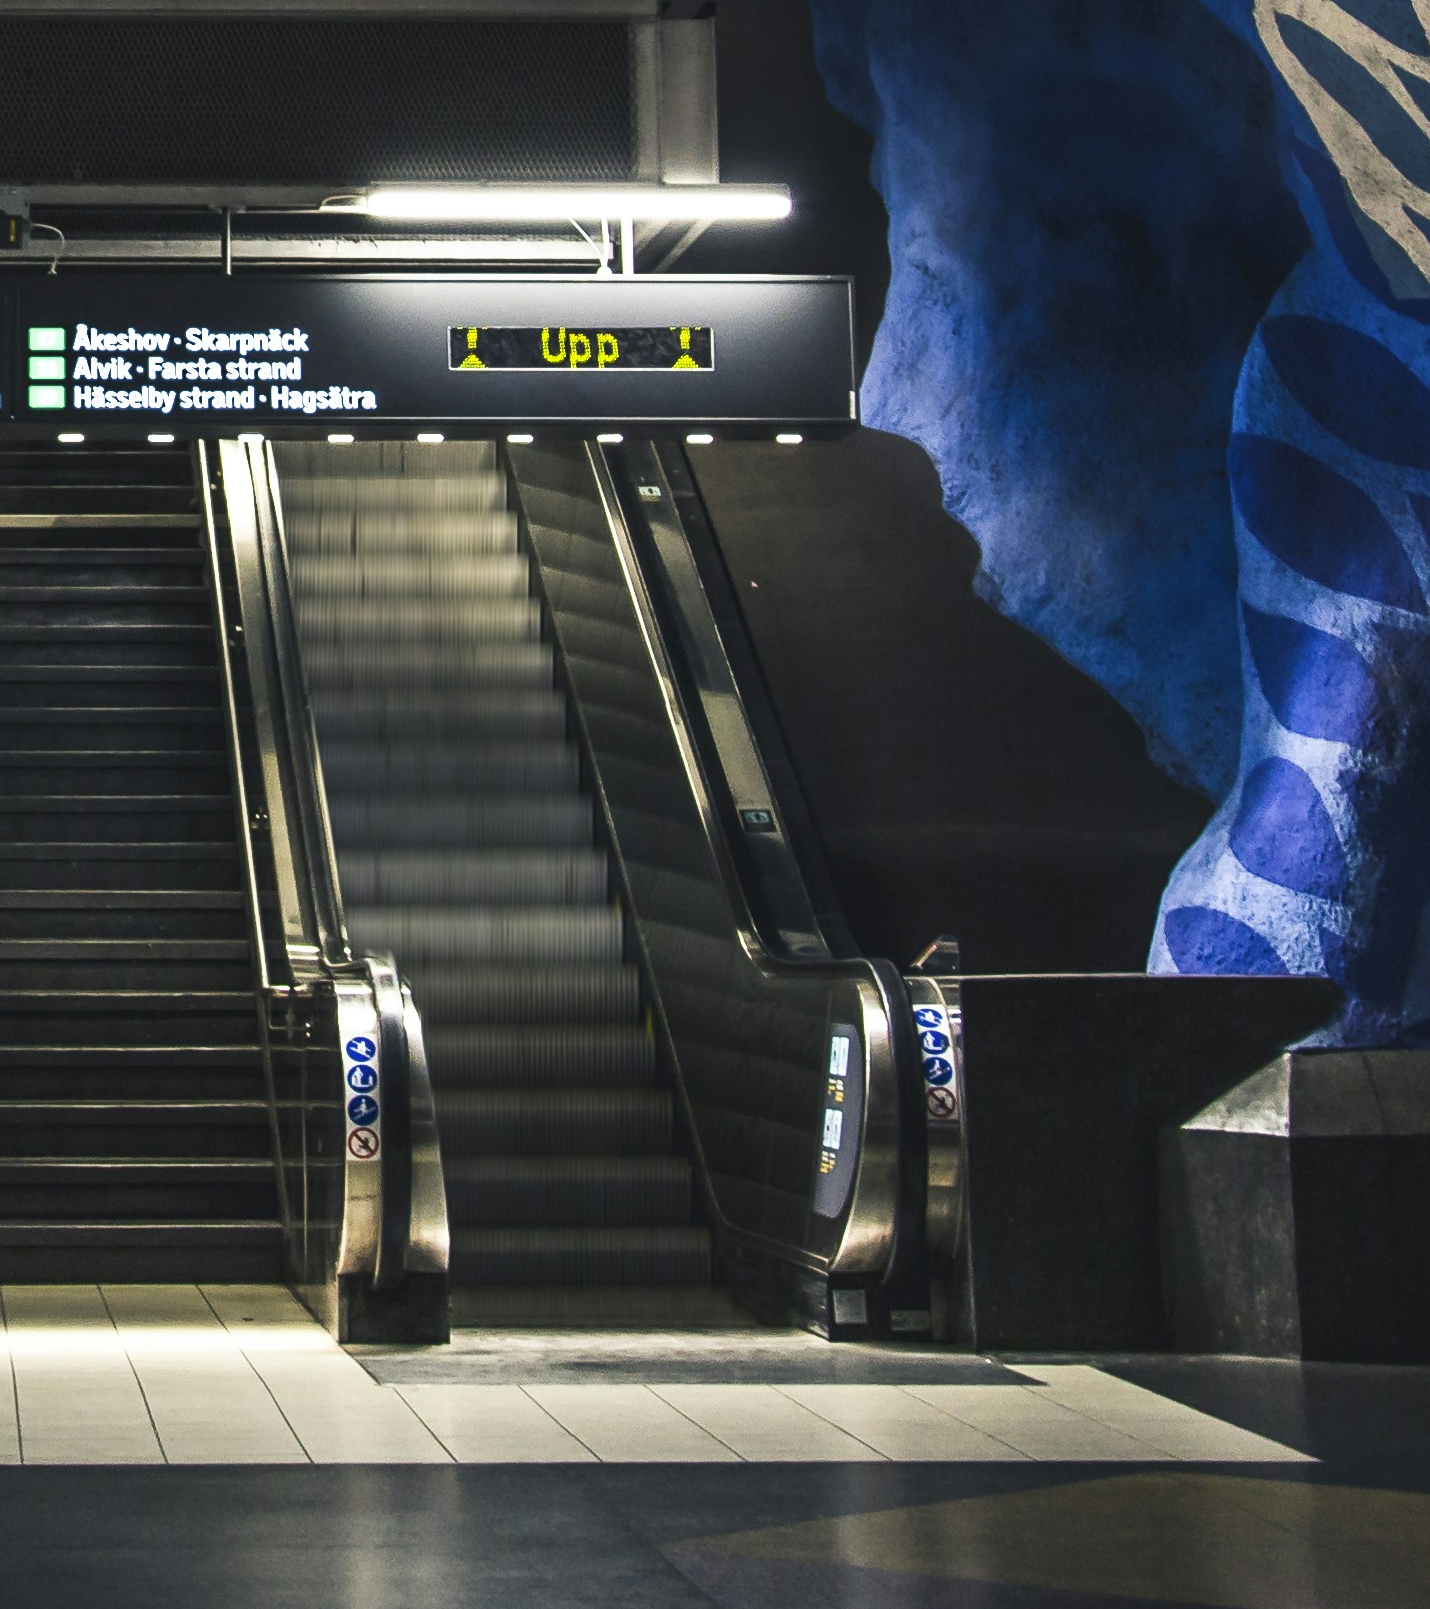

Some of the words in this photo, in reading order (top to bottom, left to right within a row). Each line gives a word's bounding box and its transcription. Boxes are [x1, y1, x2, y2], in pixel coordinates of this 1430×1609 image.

[73, 323, 170, 351] Åkeshov
[185, 327, 310, 355] Skarpnäck
[541, 326, 620, 369] Upp
[73, 356, 133, 380] Alvik
[148, 356, 223, 380] Farsta
[225, 356, 302, 381] strand
[73, 385, 177, 414] Hässelby
[179, 385, 255, 409] strand
[270, 385, 378, 414] Hagsätra
